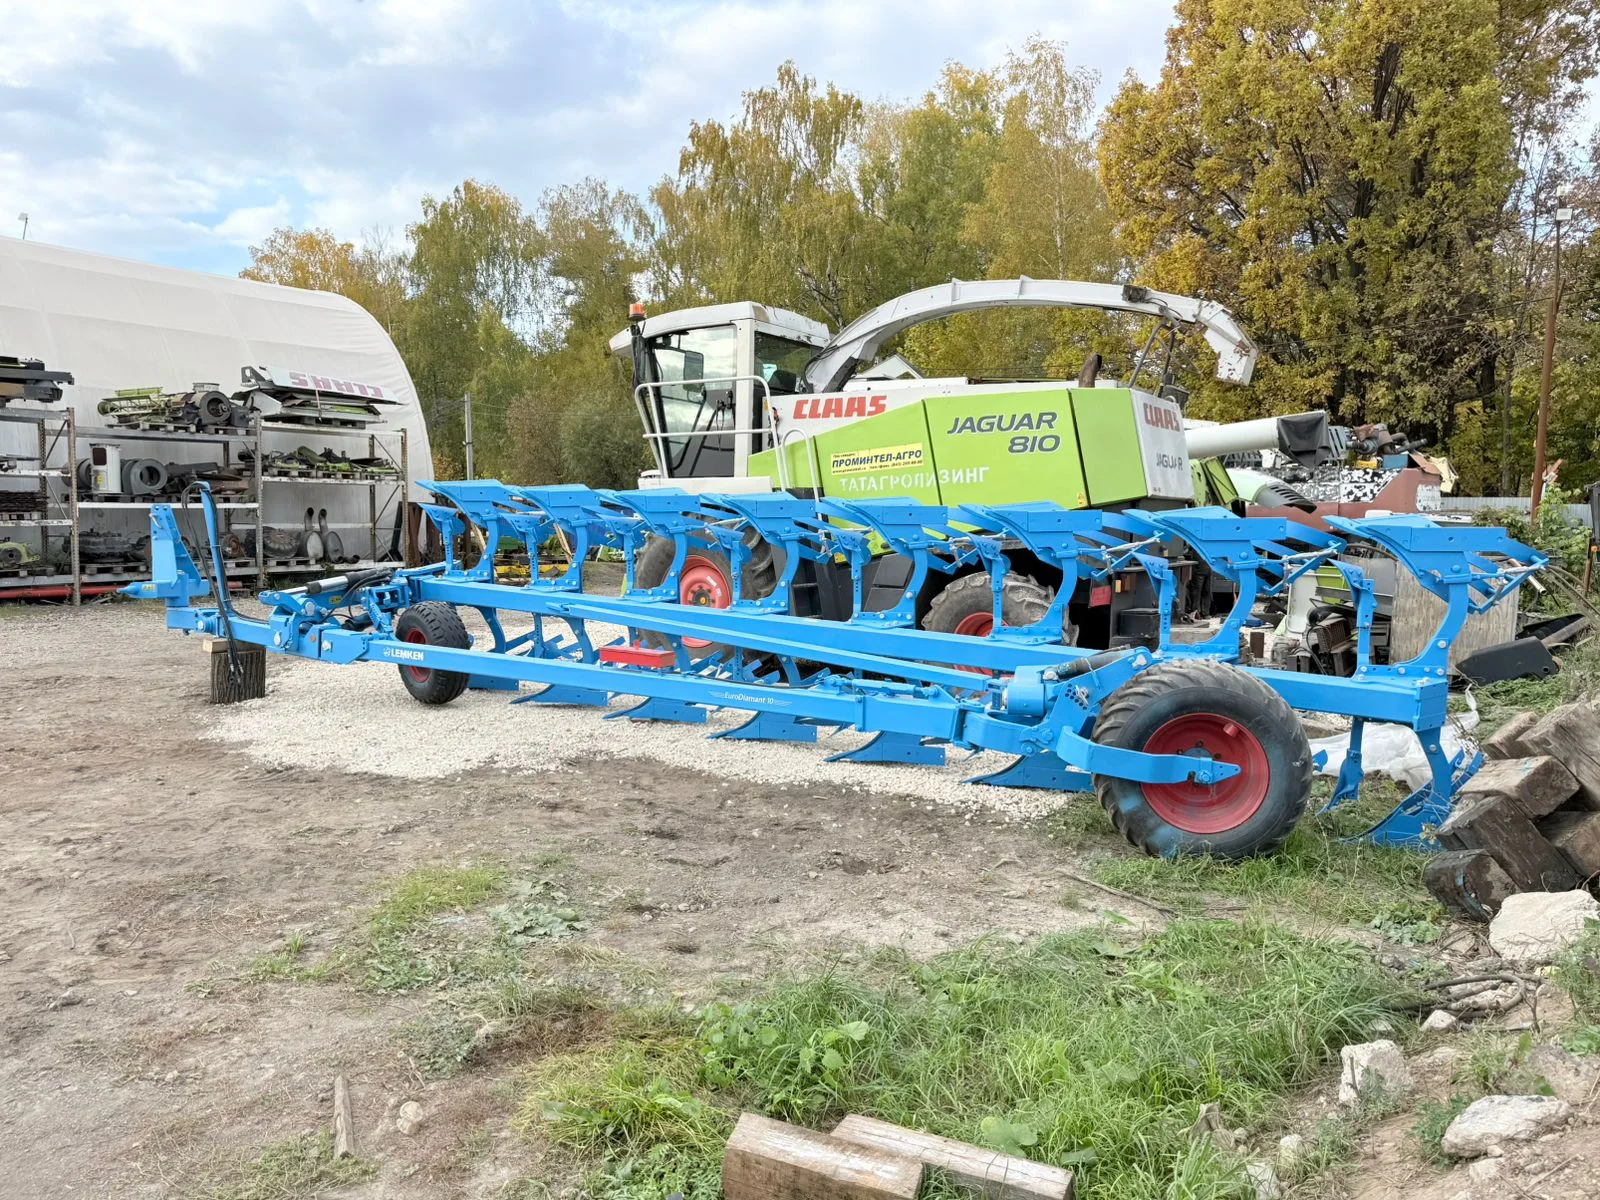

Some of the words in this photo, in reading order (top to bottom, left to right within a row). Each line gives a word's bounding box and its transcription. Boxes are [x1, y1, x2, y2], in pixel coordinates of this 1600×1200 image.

[288, 371, 384, 399] CLAAS
[793, 395, 887, 419] CLAAS
[1143, 402, 1181, 433] CLAAS
[946, 411, 1058, 434] JAGUAR
[1008, 434, 1061, 454] 810
[832, 449, 922, 469] ПРОМИНТЕЛ-АГРО
[391, 648, 424, 661] LEMKEN
[724, 691, 766, 704] EuroDiamant
